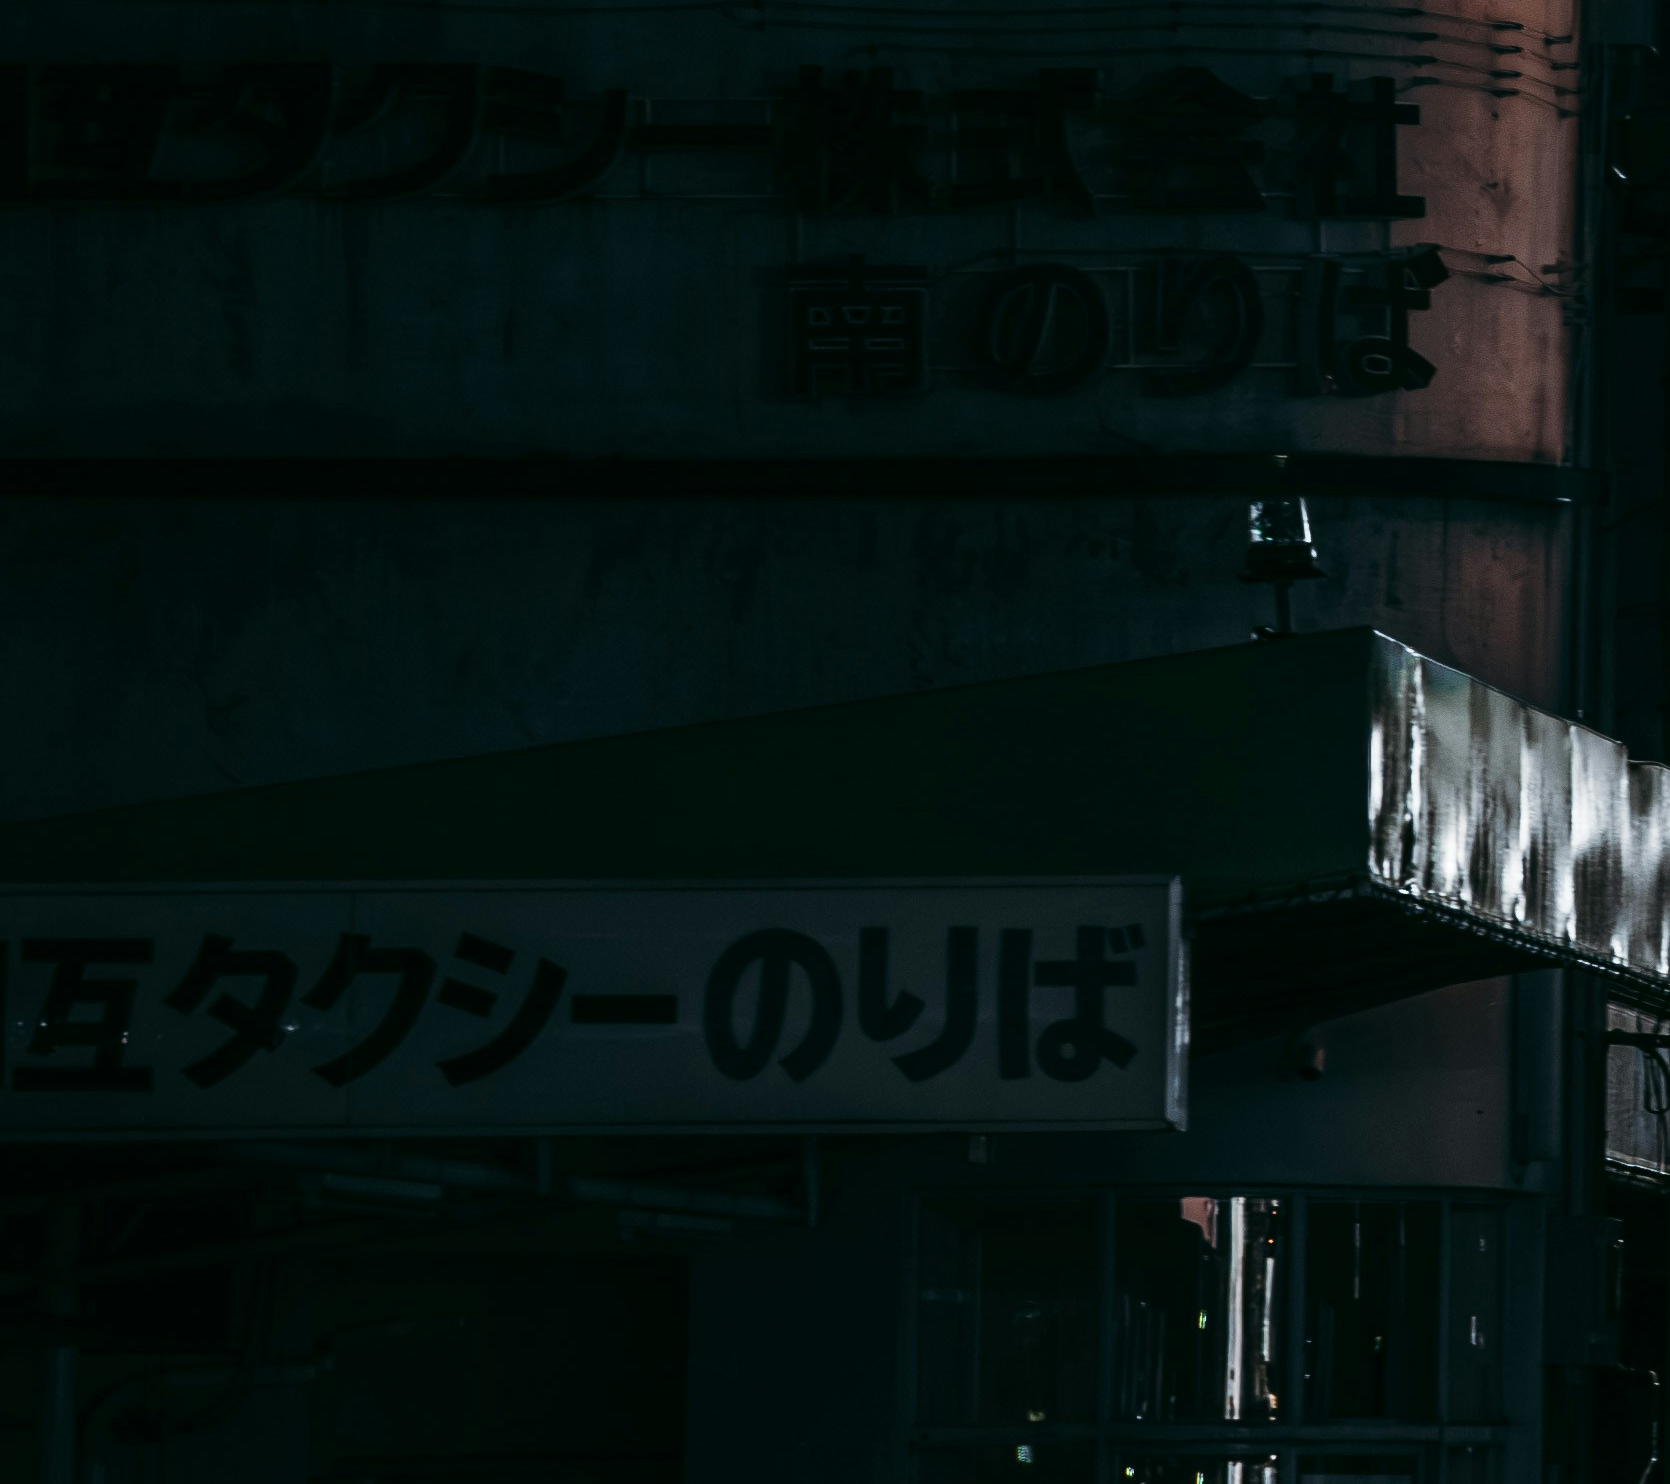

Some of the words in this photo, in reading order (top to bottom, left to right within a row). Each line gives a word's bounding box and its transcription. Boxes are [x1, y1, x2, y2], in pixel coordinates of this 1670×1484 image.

[0, 924, 1147, 1092] 互タクシーのりば
